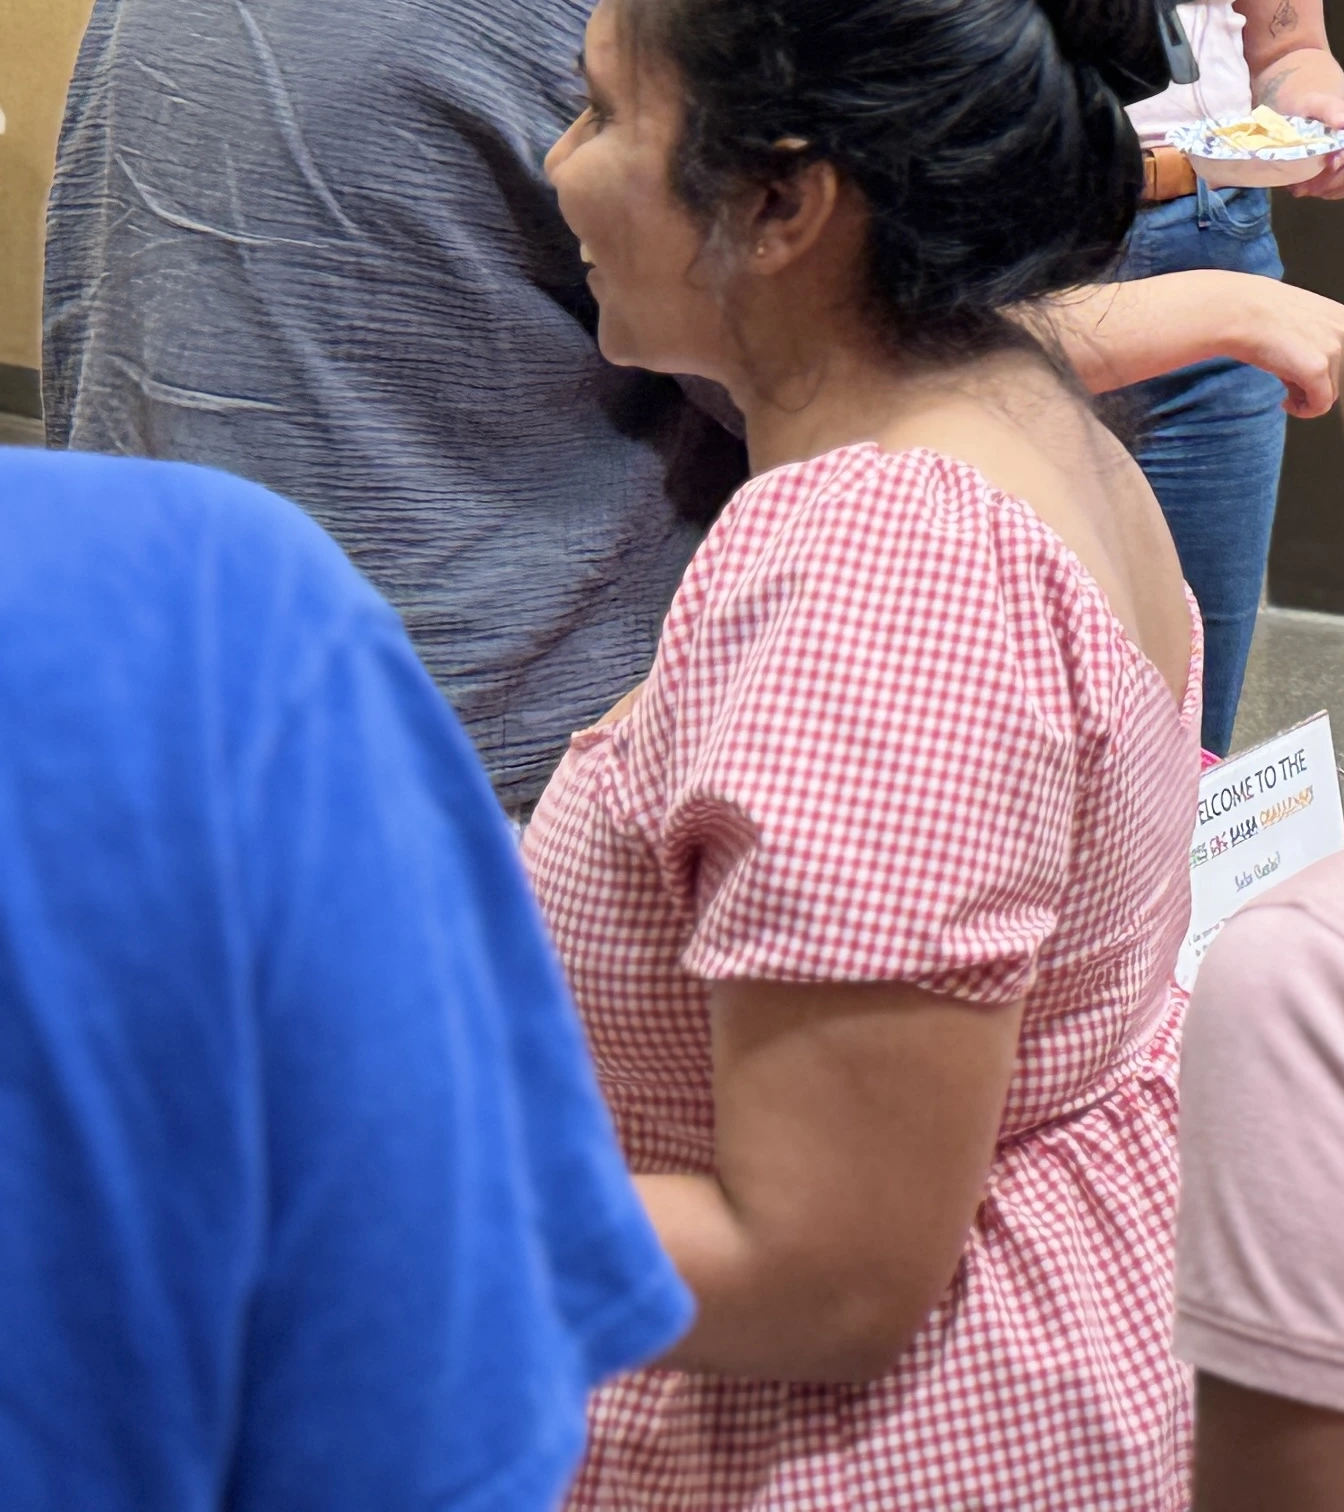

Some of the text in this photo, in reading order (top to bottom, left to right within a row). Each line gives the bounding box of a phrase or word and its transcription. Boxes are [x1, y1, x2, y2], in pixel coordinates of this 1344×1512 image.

[1197, 776, 1254, 826] ELCOME
[1255, 764, 1278, 794] TO
[1278, 748, 1308, 782] THE
